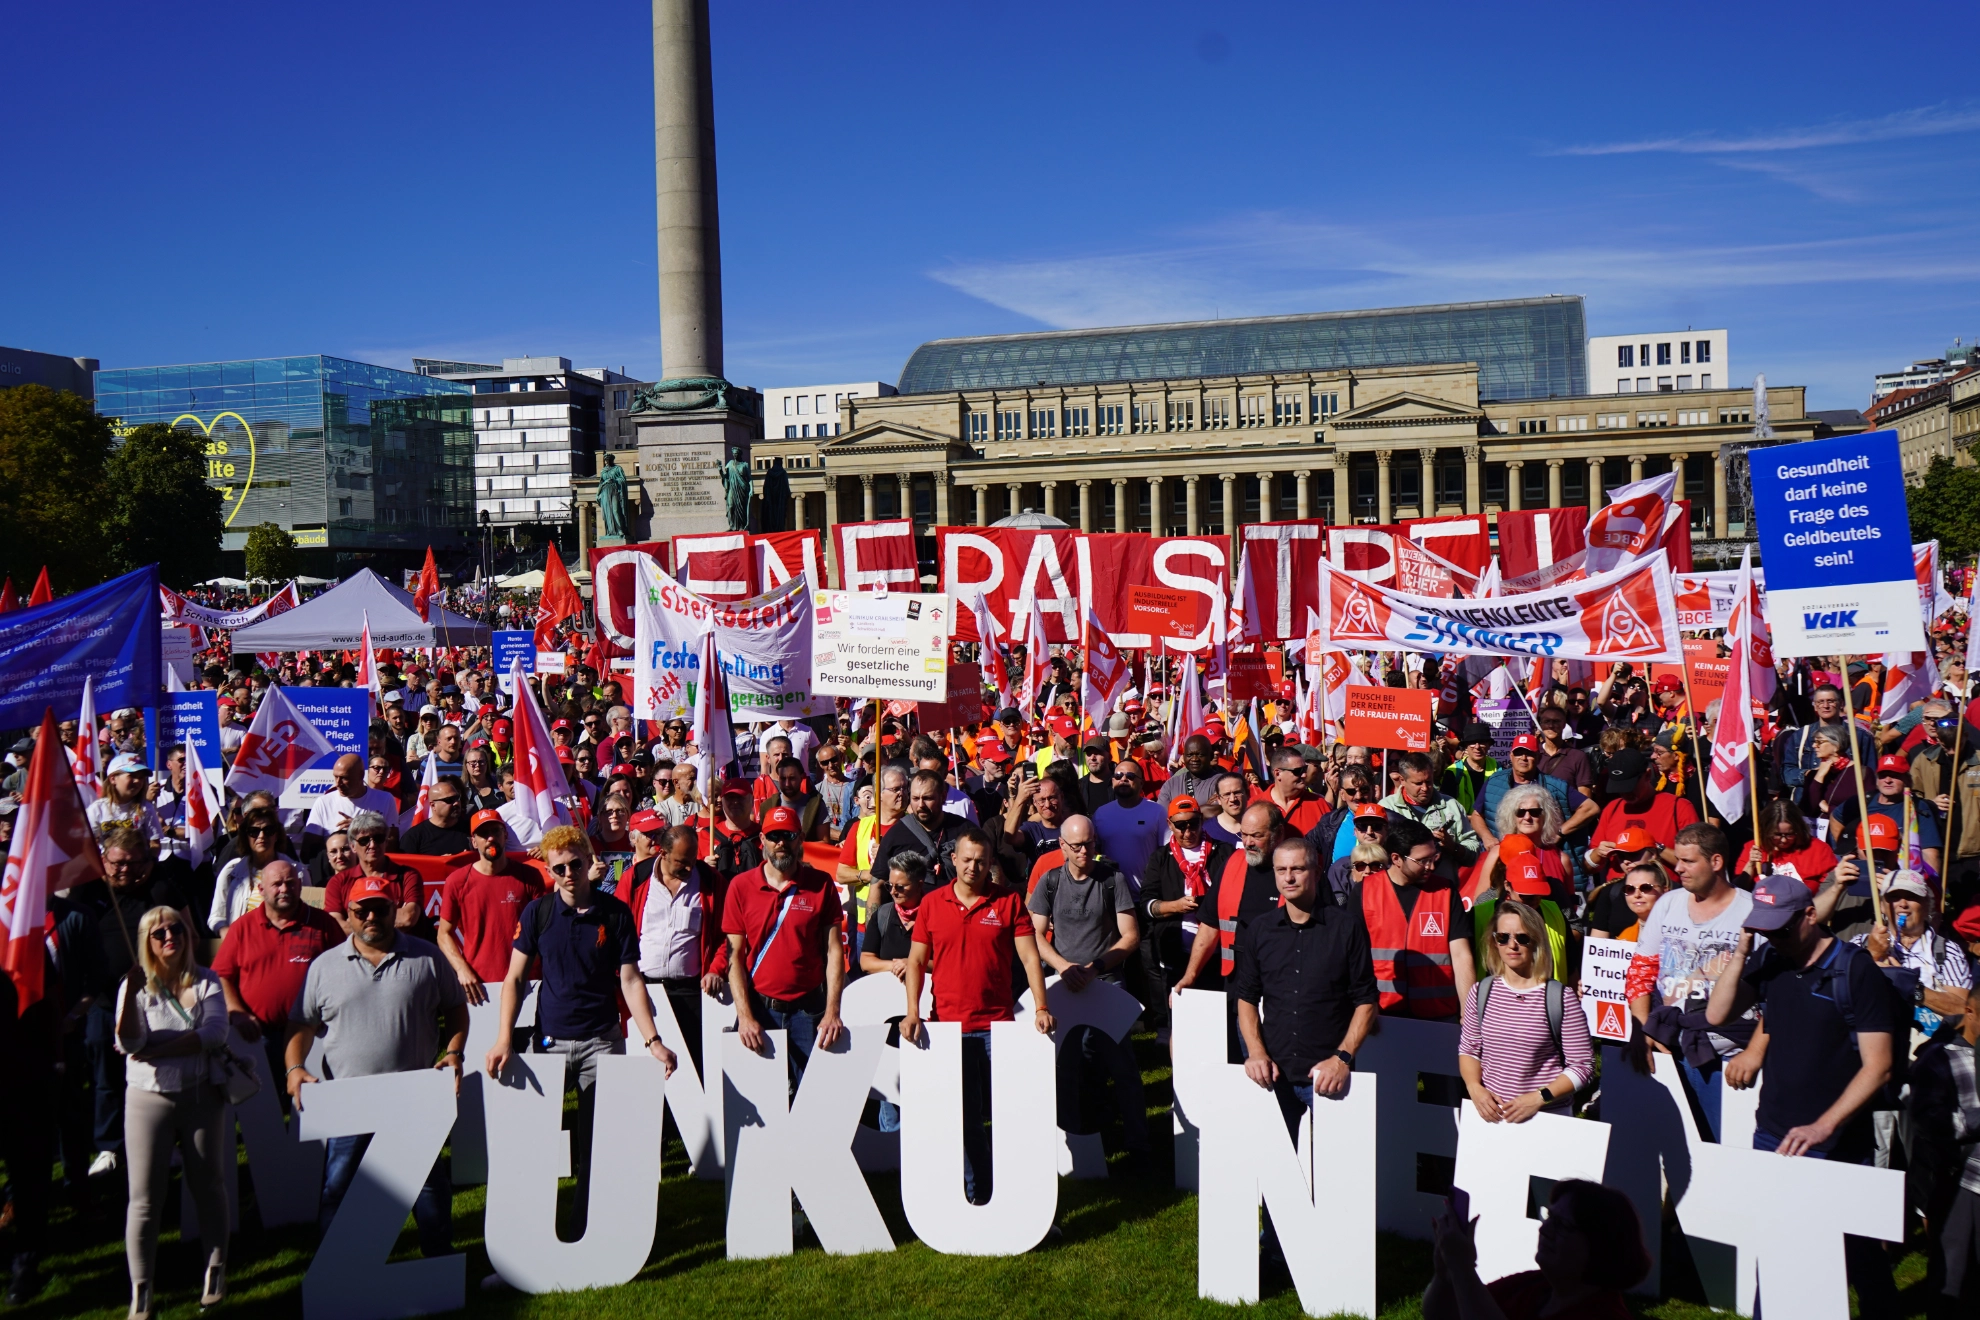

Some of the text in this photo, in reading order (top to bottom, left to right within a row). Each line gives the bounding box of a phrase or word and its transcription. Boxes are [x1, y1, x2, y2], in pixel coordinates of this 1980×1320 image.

[0, 361, 21, 374] alia
[205, 440, 228, 455] as
[645, 461, 718, 472] KOENIG WILHELM
[1777, 455, 1869, 479] Gesundheit
[1785, 480, 1867, 502] darf keine
[1789, 502, 1869, 525] Frage des
[1783, 524, 1881, 547] Geldbeutels
[1814, 550, 1854, 567] sein!
[1134, 591, 1176, 601] AUSBILDUNG
[1134, 598, 1178, 608] INDUSTRIELLE
[1802, 602, 1860, 610] SOZIALVERBAND
[1133, 605, 1171, 614] VORSORGE.
[1803, 610, 1859, 629] VdK
[332, 633, 426, 643] www.scmid-audio.de
[837, 643, 920, 656] Wir fordern eine
[847, 660, 910, 671] gesetzliche
[1694, 662, 1713, 671] KEIN
[820, 672, 937, 690] Personalbemessung!
[1708, 672, 1729, 680] UNSE
[647, 671, 681, 710] statt
[1351, 692, 1381, 701] PFUSCH
[297, 704, 352, 713] Einheit statt
[1351, 701, 1396, 711] DER RENTE:
[160, 715, 177, 723] darf
[1350, 708, 1425, 722] FÜR FRAUEN FATAL.
[1481, 710, 1529, 719] Mein Gehalt
[311, 718, 350, 728] altung in
[162, 727, 185, 737] Frage
[325, 731, 354, 741] Pflege
[300, 783, 334, 794] VdK
[1661, 925, 1688, 937] CAMP
[1588, 944, 1632, 961] Daimle
[1583, 985, 1627, 1001] Zentra
